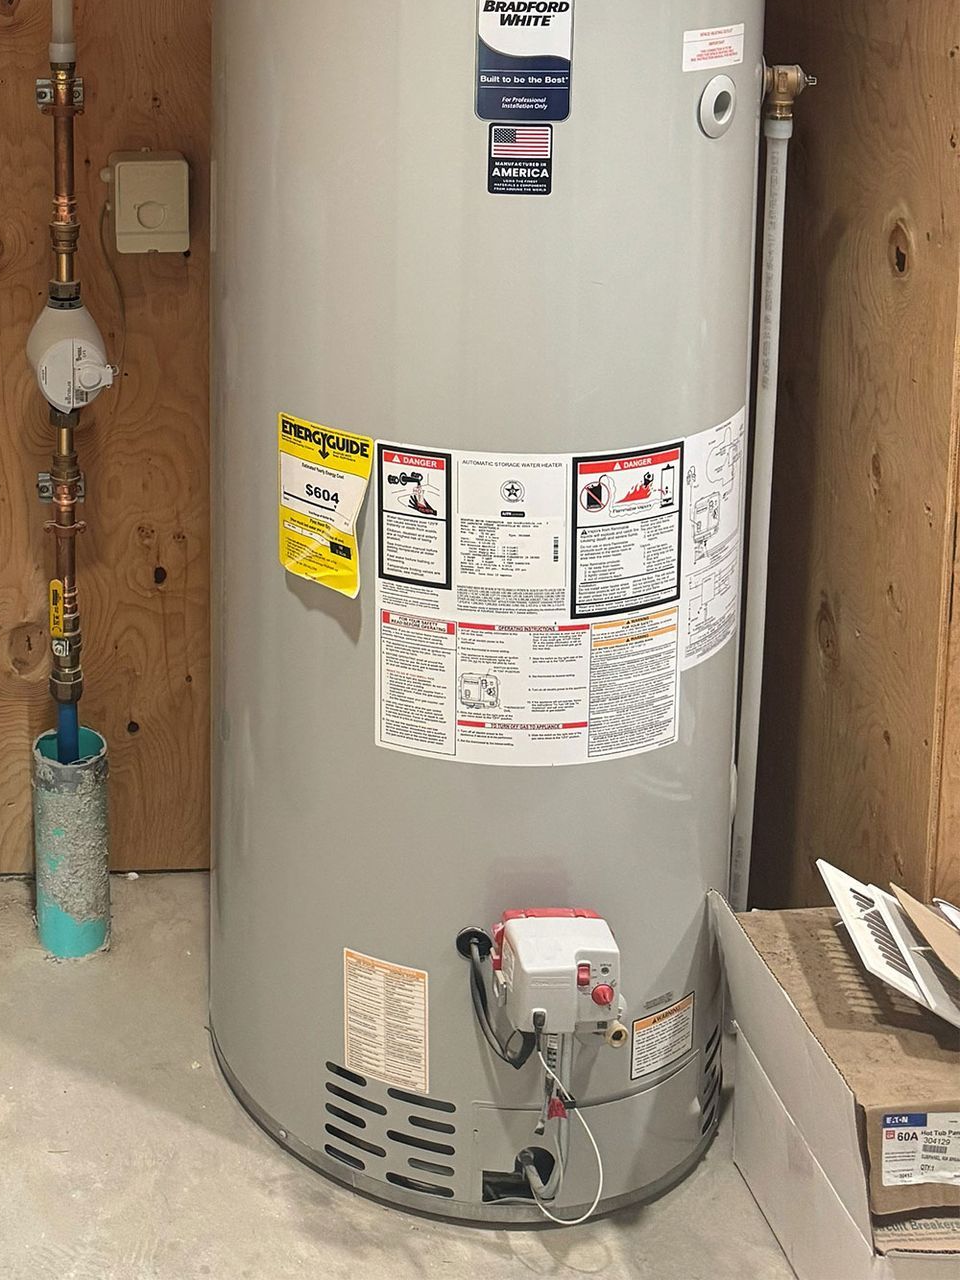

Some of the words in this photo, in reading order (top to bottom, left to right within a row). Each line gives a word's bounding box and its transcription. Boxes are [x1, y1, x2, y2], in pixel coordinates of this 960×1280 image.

[483, 0, 570, 13] BRADFORD
[499, 13, 552, 27] WHITE
[480, 75, 500, 83] Built
[513, 75, 525, 84] be
[528, 76, 542, 84] the
[512, 96, 547, 104] Professional
[534, 103, 548, 111] Only
[492, 167, 549, 178] AMERICA
[281, 418, 370, 459] ENERGYGUIDE
[403, 456, 437, 468] DANGER
[461, 459, 494, 467] AUTOMATIC
[623, 457, 653, 469] DANGER
[305, 483, 340, 505] $604
[897, 1131, 919, 1142] 60A
[923, 1136, 951, 1146] 304129
